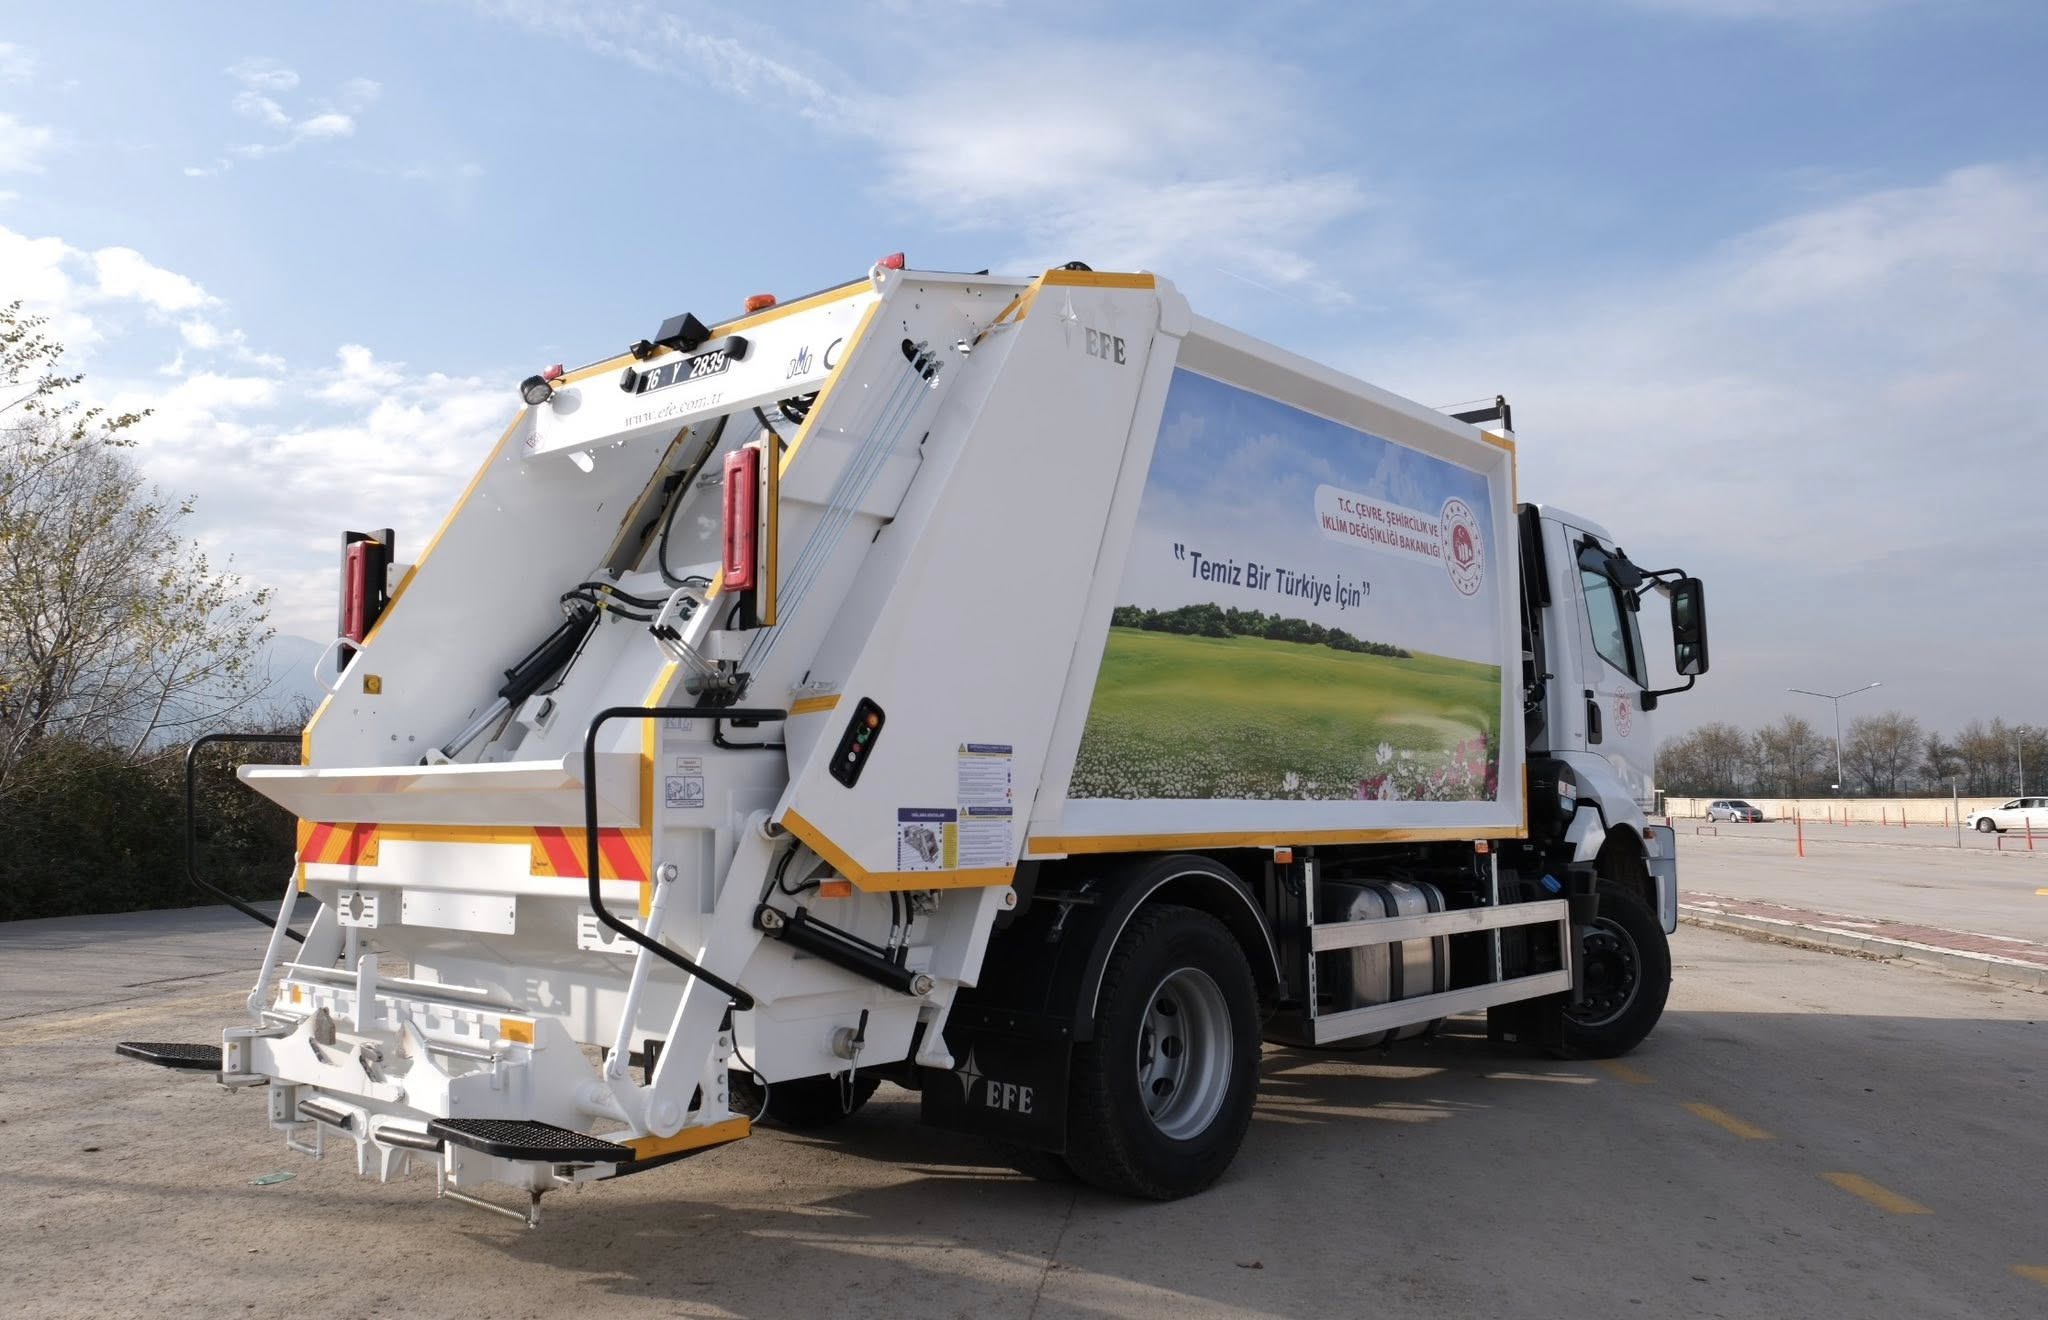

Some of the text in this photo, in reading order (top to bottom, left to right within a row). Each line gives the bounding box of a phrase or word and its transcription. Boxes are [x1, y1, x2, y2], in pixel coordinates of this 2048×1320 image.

[1085, 327, 1126, 365] EFE
[646, 350, 724, 391] 16 Y 2839
[625, 392, 723, 426] www.efe.com.tr
[1322, 512, 1441, 559] İKLİM DEĞİŞİKLİĞİ BAKANLIĞI
[1338, 498, 1439, 537] T.C. ÇEVRE, ŞEHİRCİLİK VE
[1246, 563, 1271, 591] Bir
[1276, 568, 1332, 607] Türkiye
[986, 1080, 1033, 1114] EFE
